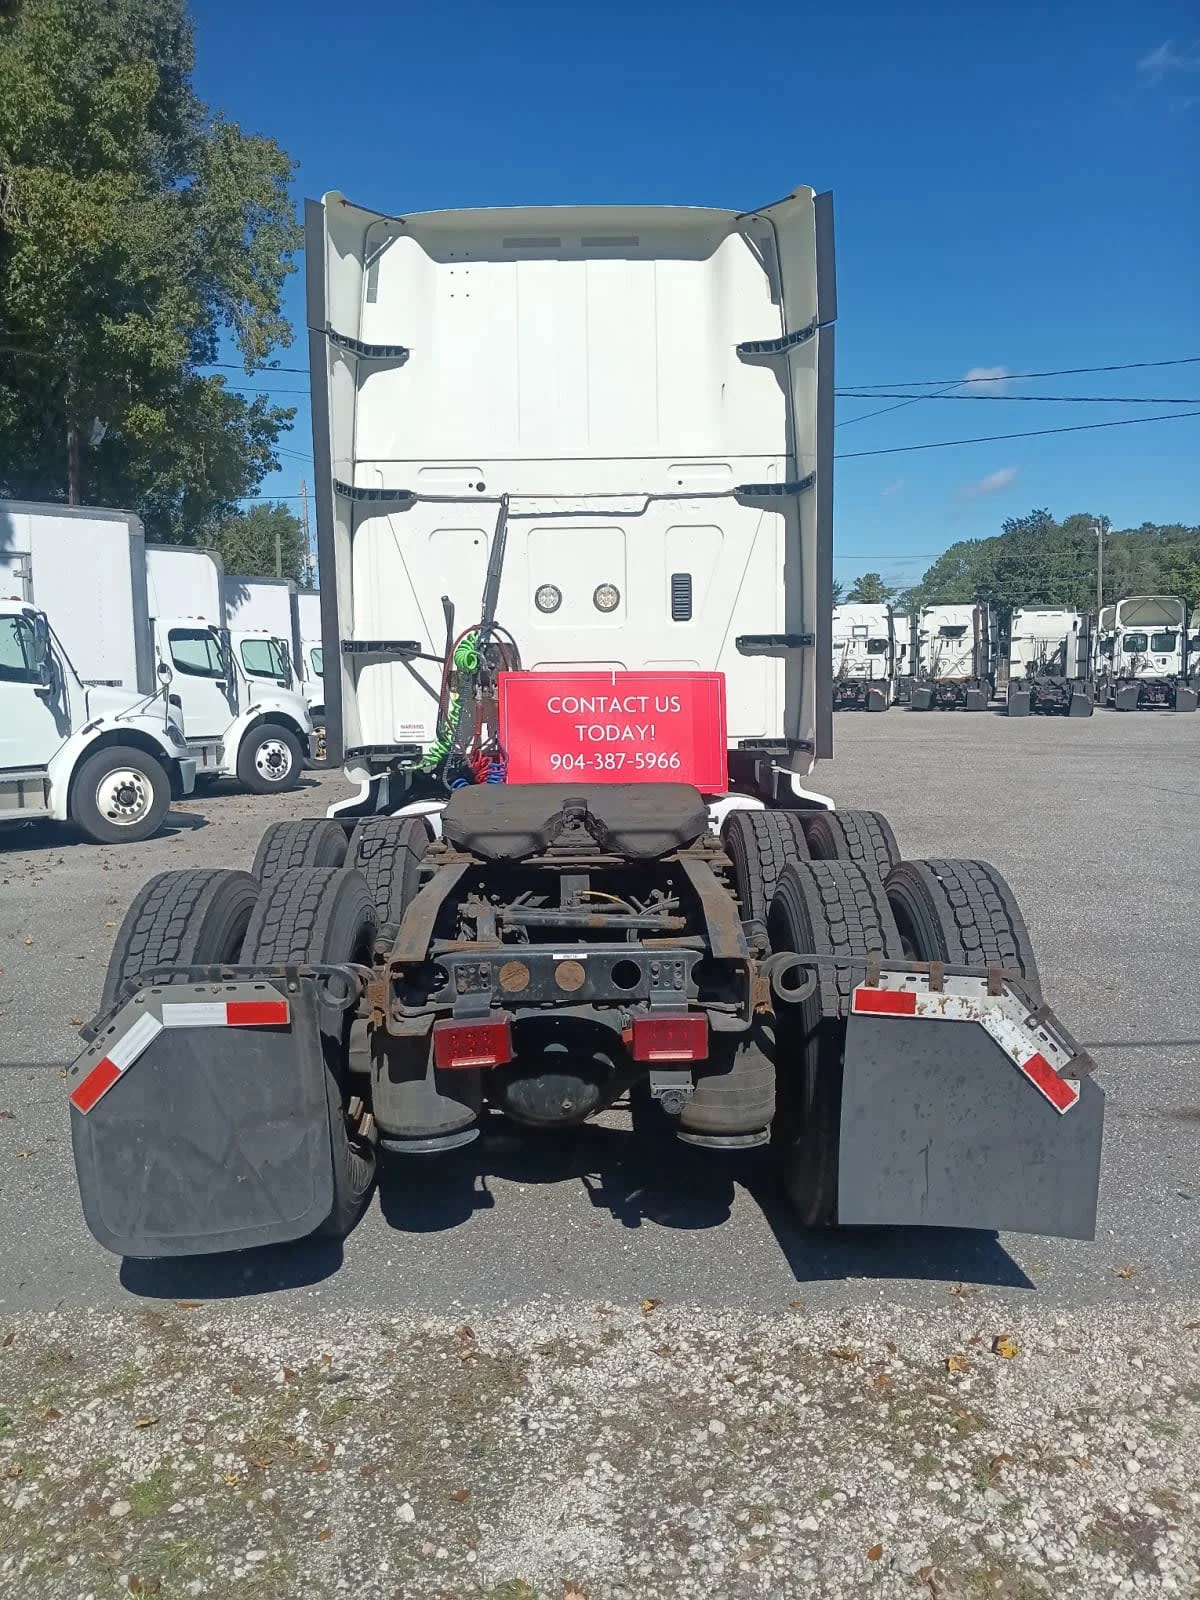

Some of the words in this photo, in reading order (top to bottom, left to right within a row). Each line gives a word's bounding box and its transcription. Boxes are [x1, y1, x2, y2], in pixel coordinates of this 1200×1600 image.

[547, 696, 650, 713] CONTACT
[655, 696, 681, 713] US
[575, 724, 656, 741] TODAY!
[550, 752, 681, 770] 904-387-5966
